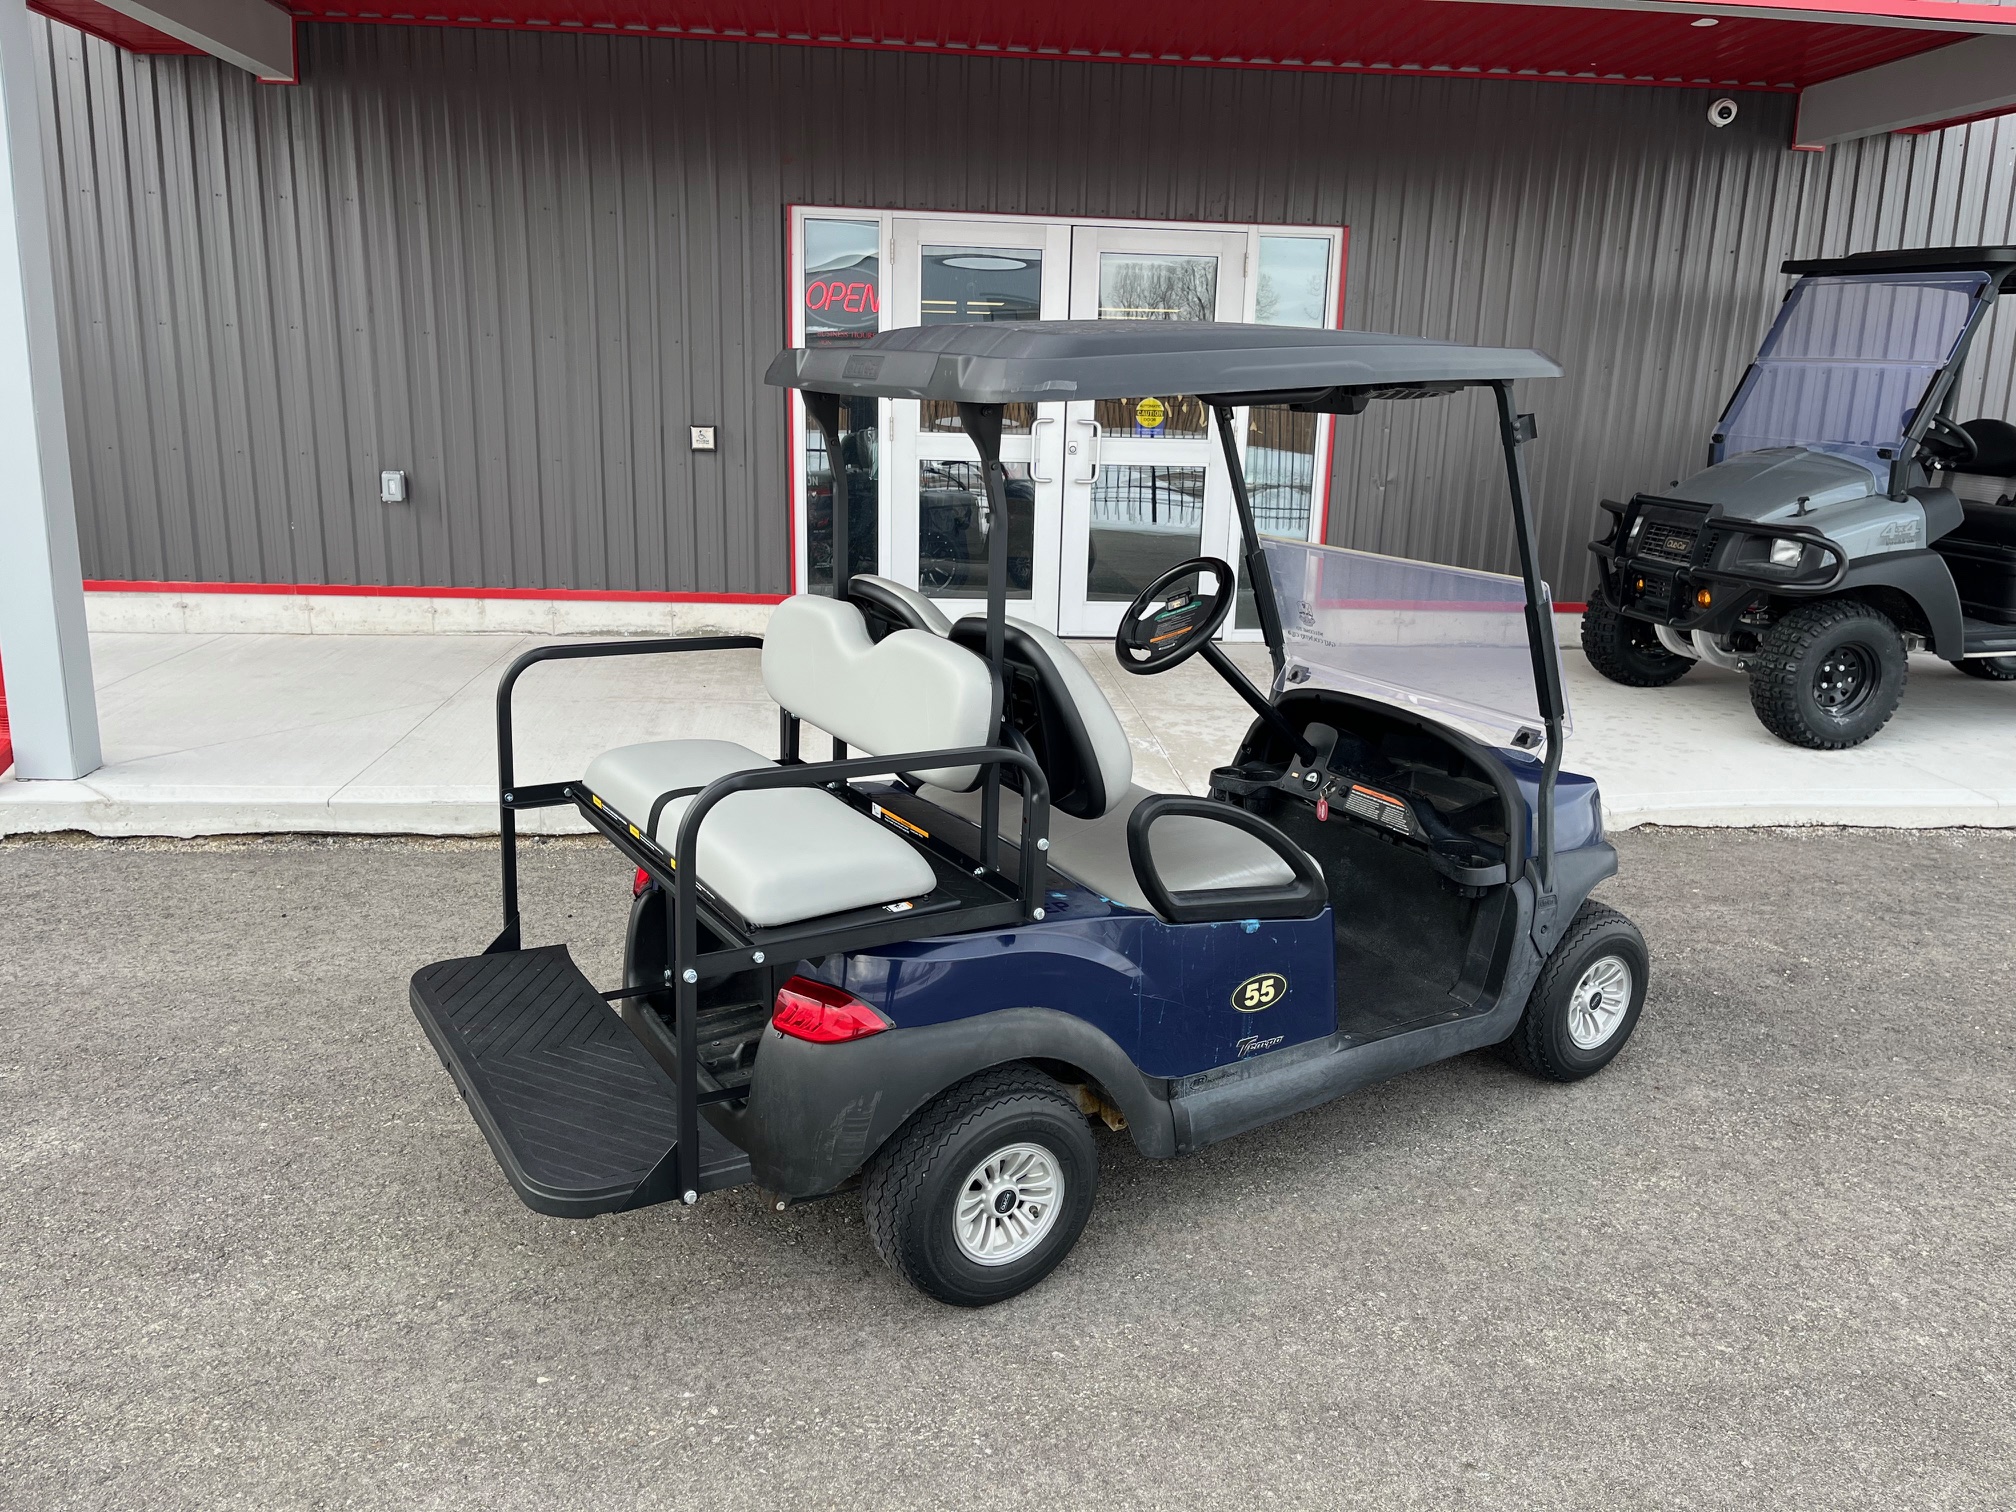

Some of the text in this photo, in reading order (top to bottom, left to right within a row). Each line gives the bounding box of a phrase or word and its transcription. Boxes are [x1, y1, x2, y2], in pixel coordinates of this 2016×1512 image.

[806, 281, 880, 312] OPEN
[1880, 520, 1920, 538] 4x4
[1244, 979, 1275, 1007] 55
